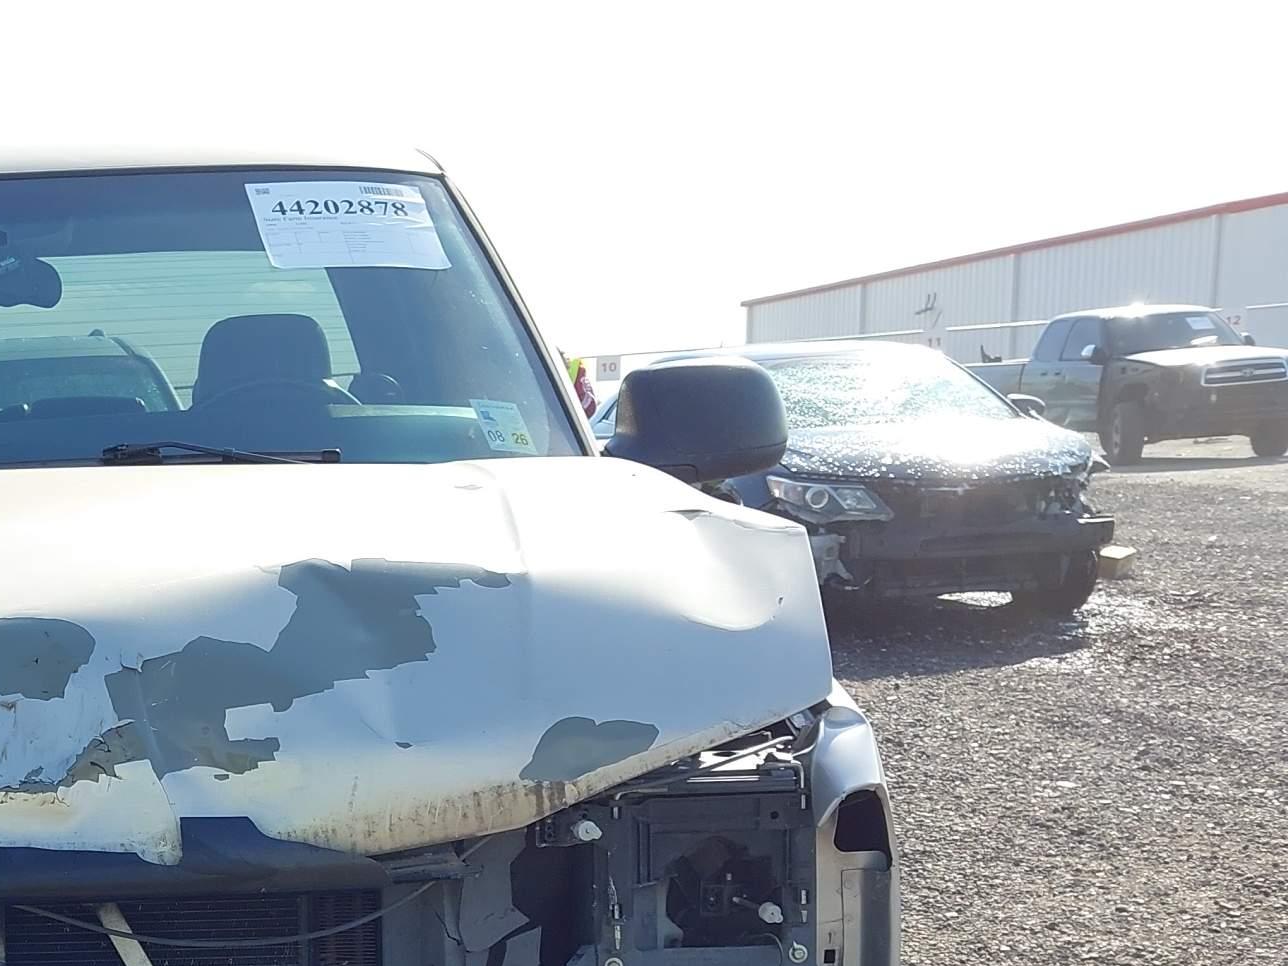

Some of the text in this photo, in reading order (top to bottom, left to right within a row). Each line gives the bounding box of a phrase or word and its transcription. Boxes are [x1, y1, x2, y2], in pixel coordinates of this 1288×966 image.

[271, 199, 409, 217] 44202878
[601, 362, 617, 373] 10
[487, 430, 529, 446] 08 26
